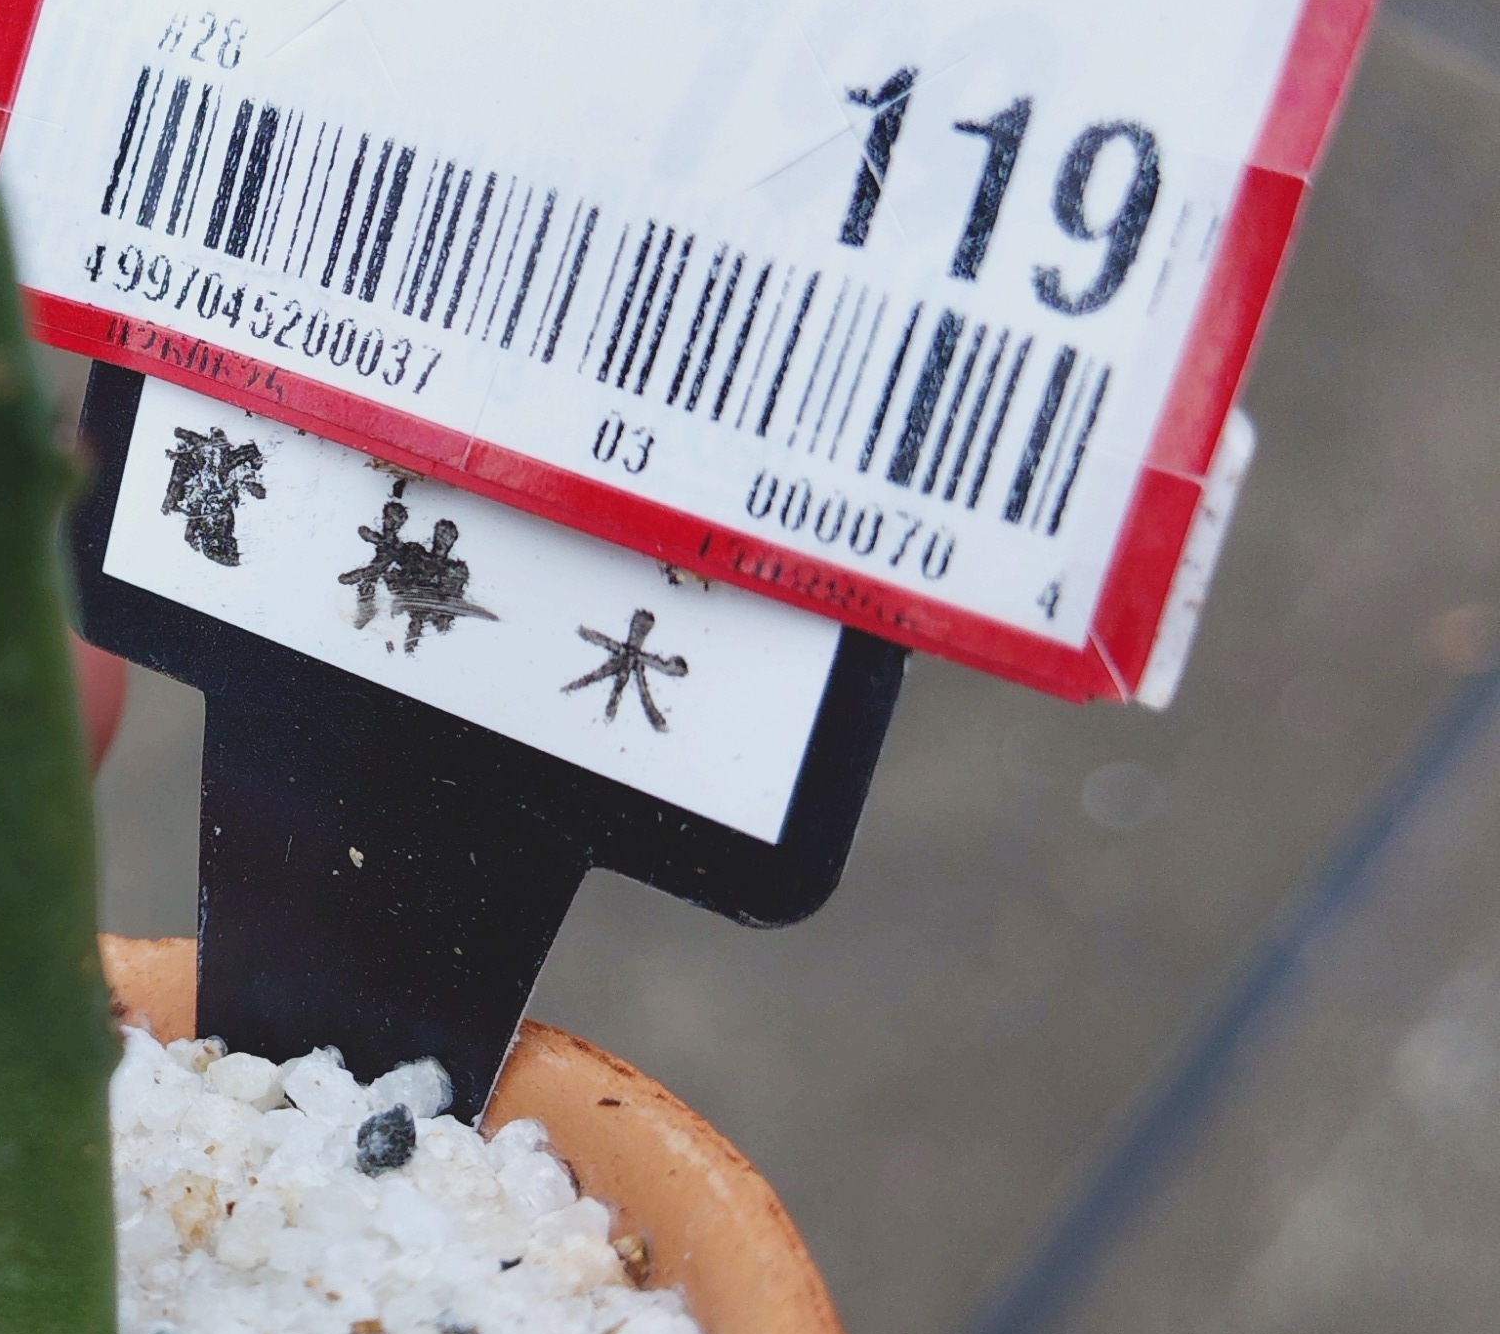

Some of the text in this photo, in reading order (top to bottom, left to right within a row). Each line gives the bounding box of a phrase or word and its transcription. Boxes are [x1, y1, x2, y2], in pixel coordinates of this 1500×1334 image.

[838, 64, 1161, 317] 119
[83, 243, 441, 395] 4997045200037
[592, 411, 656, 474] 03
[744, 467, 957, 580] 000070
[1034, 575, 1064, 620] 4
